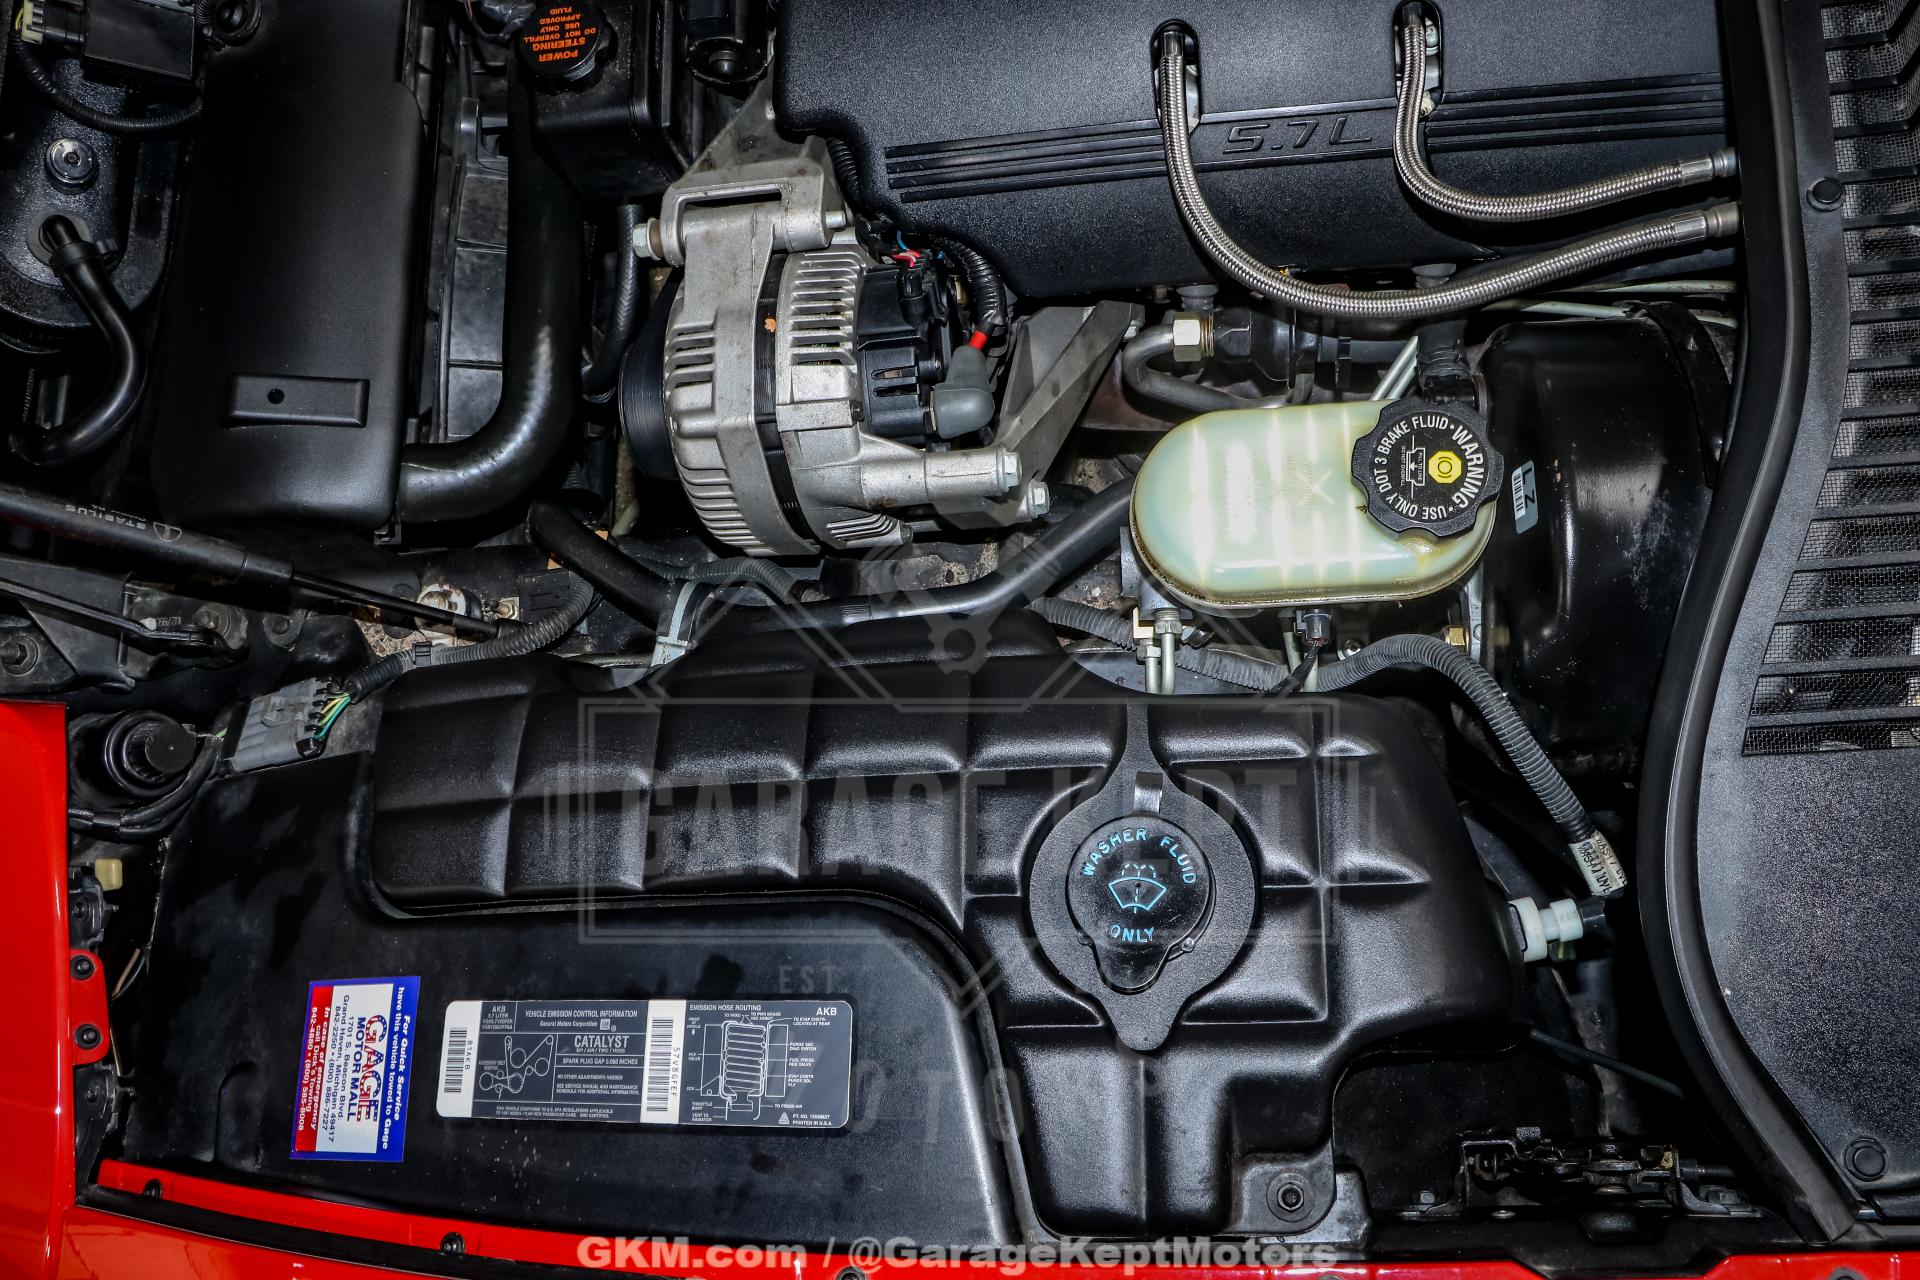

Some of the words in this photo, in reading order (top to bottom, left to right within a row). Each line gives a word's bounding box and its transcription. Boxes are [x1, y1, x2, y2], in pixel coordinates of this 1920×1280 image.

[539, 14, 581, 24] APPROVED
[550, 7, 572, 15] FLUID
[523, 33, 560, 43] OVERFILL
[540, 25, 560, 33] ONLY
[532, 38, 586, 51] STEERING
[538, 49, 579, 62] POWER
[1223, 117, 1372, 155] 5.7L
[1411, 415, 1449, 430] FLUID
[1377, 420, 1411, 455] BRAKE
[1375, 457, 1387, 465] 3
[1451, 425, 1484, 509] WARNING
[1373, 468, 1393, 493] DOT
[65, 504, 147, 530] STABILUS
[1386, 494, 1418, 518] ONLY
[1422, 506, 1447, 520] USE
[1082, 828, 1147, 876] WASHER
[1160, 836, 1197, 884] FLUID
[1109, 923, 1155, 943] ONLY
[324, 1007, 330, 1017] In
[340, 995, 349, 1024] Grand
[526, 1010, 547, 1018] VEHICLE
[547, 1010, 573, 1018] EMISSION
[816, 1007, 837, 1016] AKB
[320, 1021, 329, 1049] case
[331, 1006, 341, 1049] 842-2250
[394, 1014, 402, 1031] this
[402, 1015, 410, 1035] For
[335, 1029, 346, 1061] Haven,
[352, 1017, 366, 1073] MOTOR
[390, 1035, 400, 1069] vehicle
[574, 1035, 630, 1048] CATALYST
[311, 1046, 320, 1075] Dick's
[319, 1053, 326, 1063] of
[398, 1038, 408, 1071] Quick
[302, 1060, 312, 1083] (800)
[326, 1059, 335, 1083] (800)
[340, 1055, 350, 1091] Beacon
[357, 1015, 387, 1122] GAGE
[306, 1079, 316, 1112] Towing
[311, 1067, 324, 1130] emergency
[330, 1065, 342, 1109] Michigan
[347, 1078, 359, 1121] MALL
[386, 1072, 395, 1102] towed
[394, 1076, 404, 1121] Service
[337, 1096, 346, 1120] Blvd.
[385, 1105, 392, 1115] to
[328, 1113, 336, 1142] 49417
[382, 1118, 391, 1149] Gage
